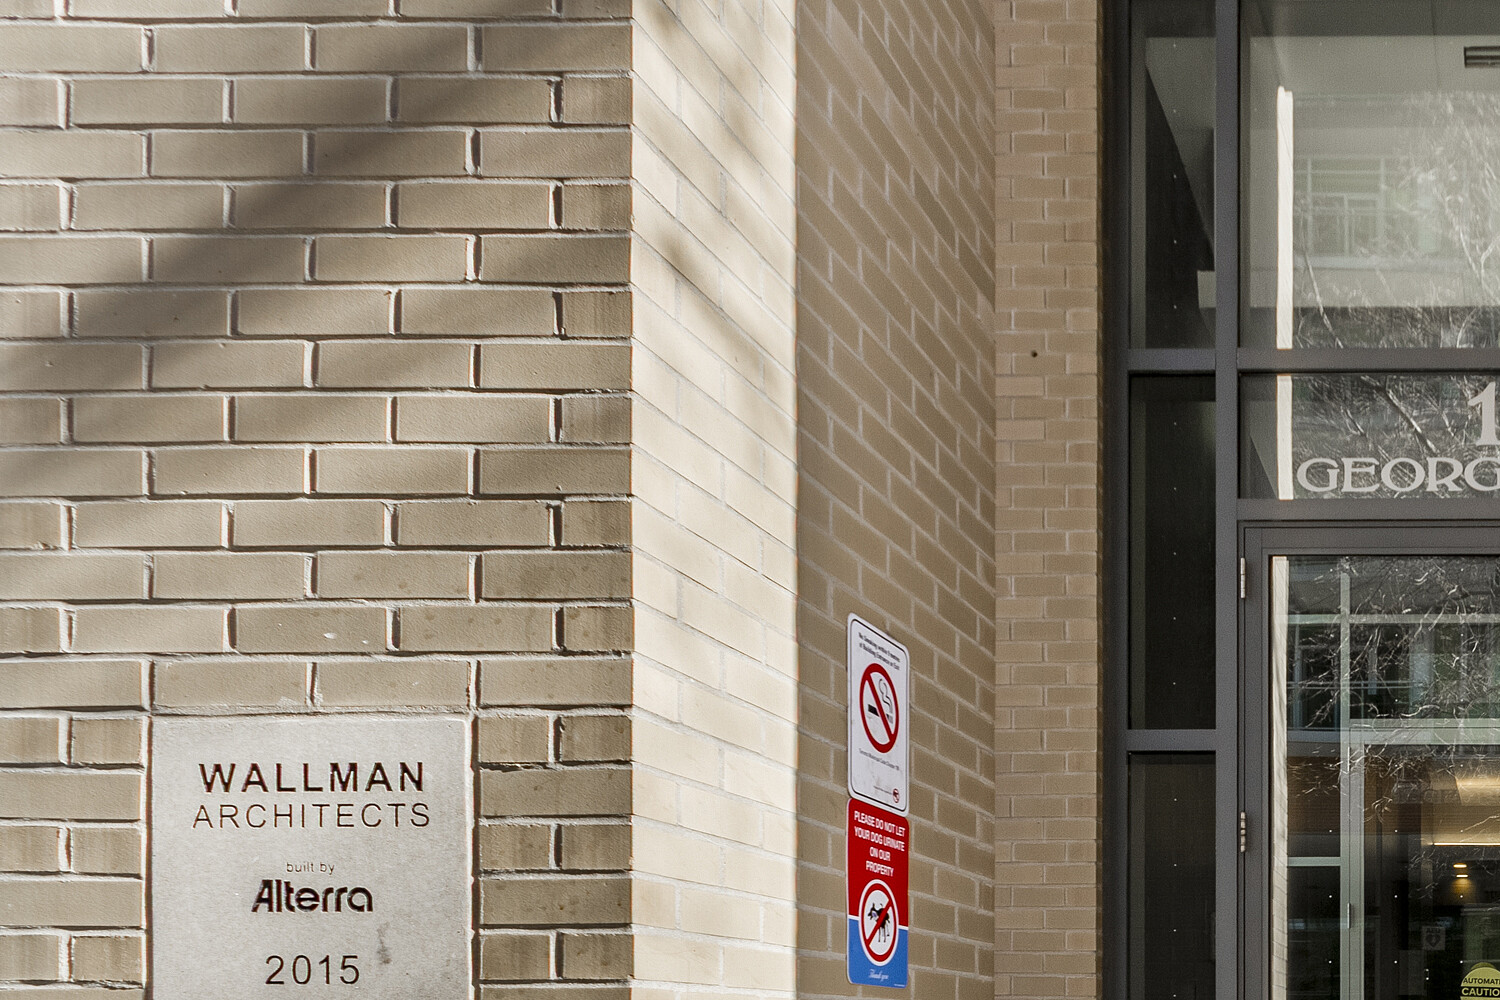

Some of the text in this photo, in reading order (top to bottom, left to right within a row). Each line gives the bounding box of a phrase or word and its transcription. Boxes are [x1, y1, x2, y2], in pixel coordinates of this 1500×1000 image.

[198, 762, 424, 793] WALLMAN
[193, 803, 430, 829] ARCHITECTS
[854, 810, 906, 837] PLEASE DO NOT LET
[854, 826, 905, 852] YOUR DOG URINATE
[870, 846, 891, 861] ON OUR
[286, 862, 335, 875] built by
[866, 860, 894, 877] PROPERTY
[251, 879, 374, 913] Alterra
[265, 955, 361, 985] 2015
